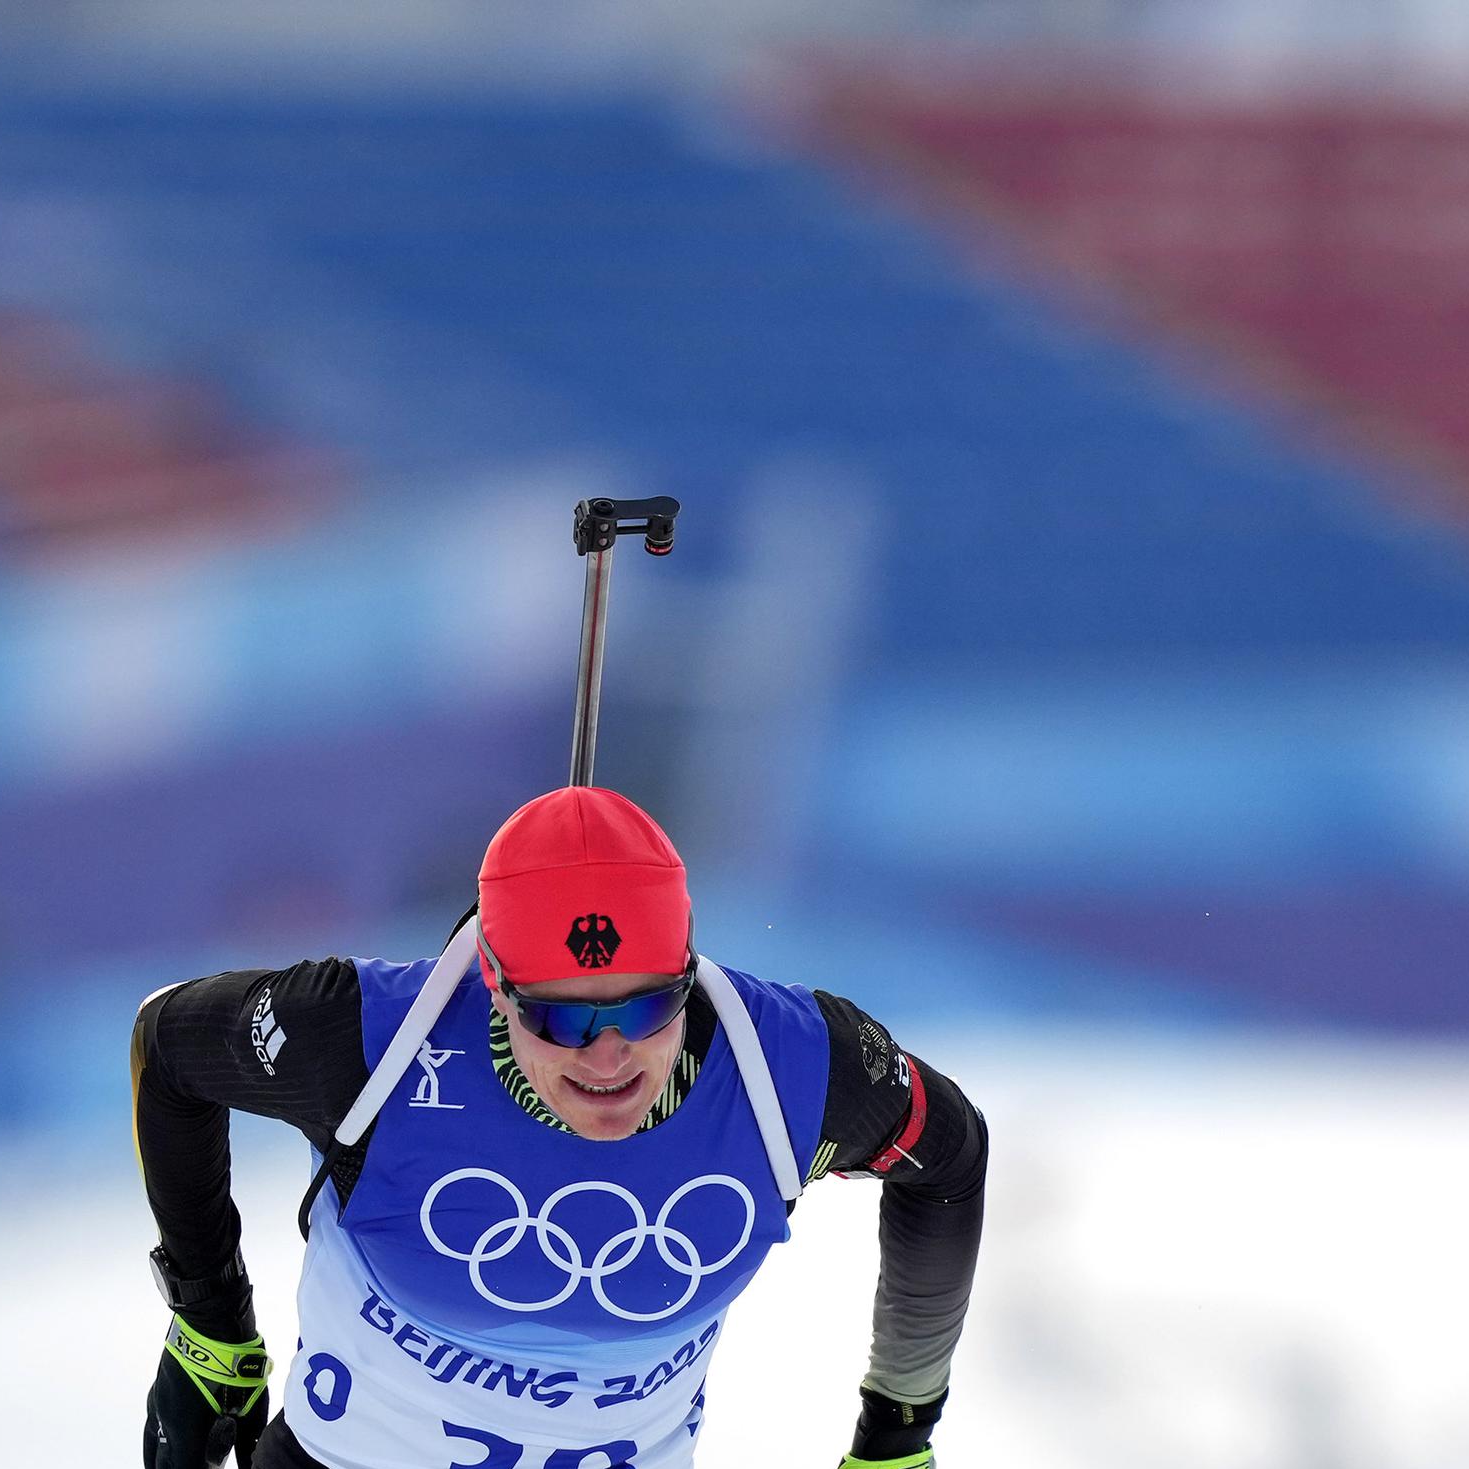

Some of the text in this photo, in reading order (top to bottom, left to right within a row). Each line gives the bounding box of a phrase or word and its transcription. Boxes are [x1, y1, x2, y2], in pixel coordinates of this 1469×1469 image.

[251, 988, 276, 1076] adidas
[359, 1282, 579, 1409] BEIJING
[593, 1320, 719, 1410] 2022
